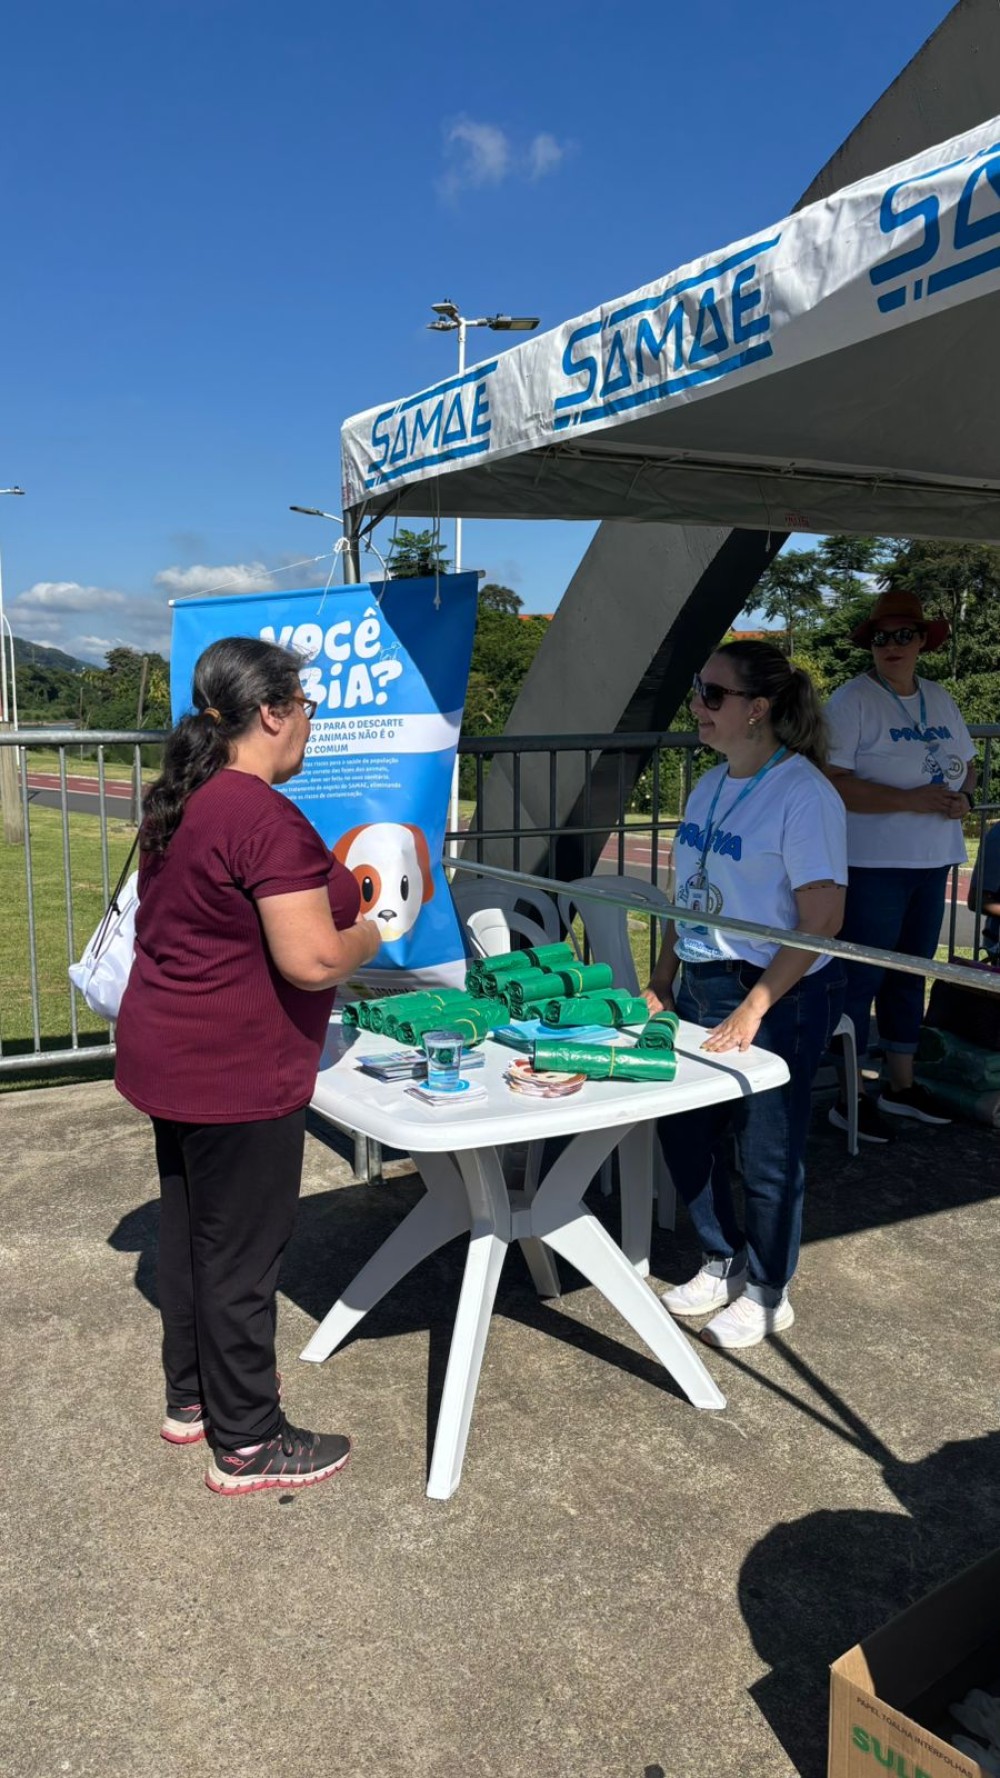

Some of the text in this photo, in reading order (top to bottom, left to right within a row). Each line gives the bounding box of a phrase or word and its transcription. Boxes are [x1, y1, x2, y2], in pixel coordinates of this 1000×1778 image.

[553, 264, 771, 410] SAMAE
[368, 382, 491, 473] SAMAE
[319, 732, 356, 742] ANIMAIS
[358, 729, 378, 740] NÃO
[388, 730, 395, 739] O
[324, 721, 347, 731] PARA
[348, 720, 355, 729] O
[357, 718, 404, 728] DESCARTE
[314, 743, 349, 754] COMUM
[857, 1697, 882, 1719] PAPEL
[882, 1715, 913, 1740] TOALHA
